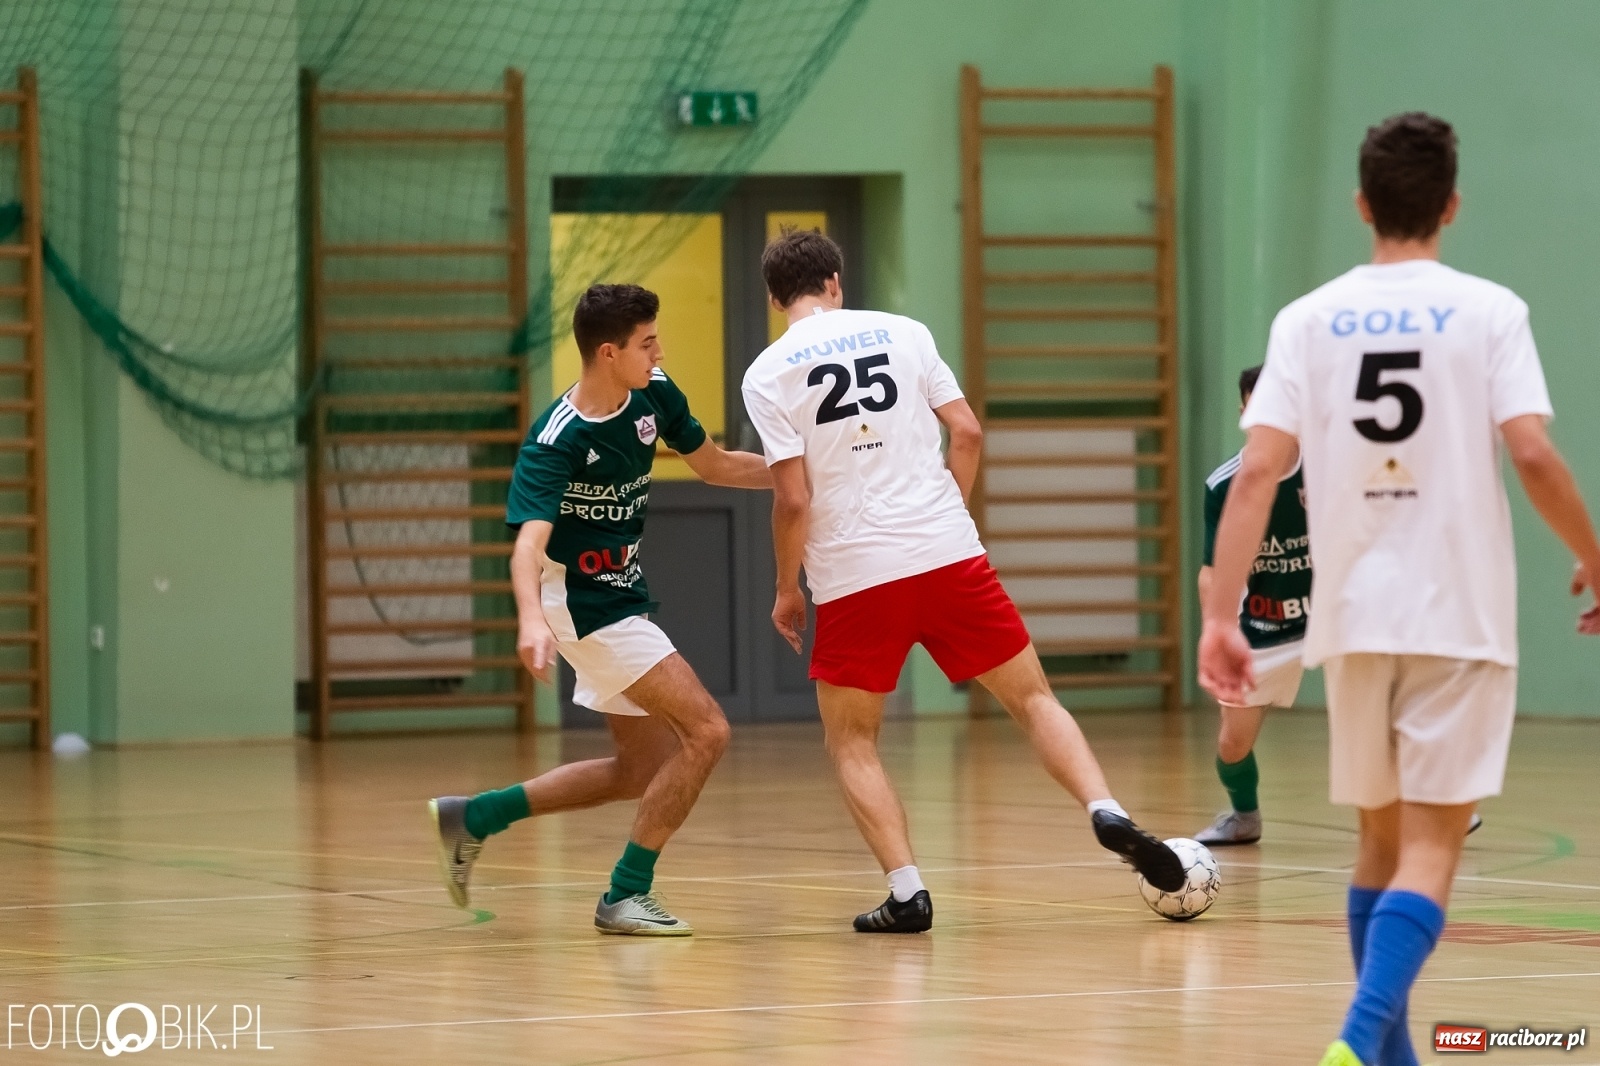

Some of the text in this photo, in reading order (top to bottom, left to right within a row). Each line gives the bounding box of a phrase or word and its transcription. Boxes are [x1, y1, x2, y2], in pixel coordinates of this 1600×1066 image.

[786, 329, 893, 365] WUWER
[1331, 307, 1455, 337] GOŁY
[807, 353, 898, 425] 25
[1352, 350, 1424, 444] 5
